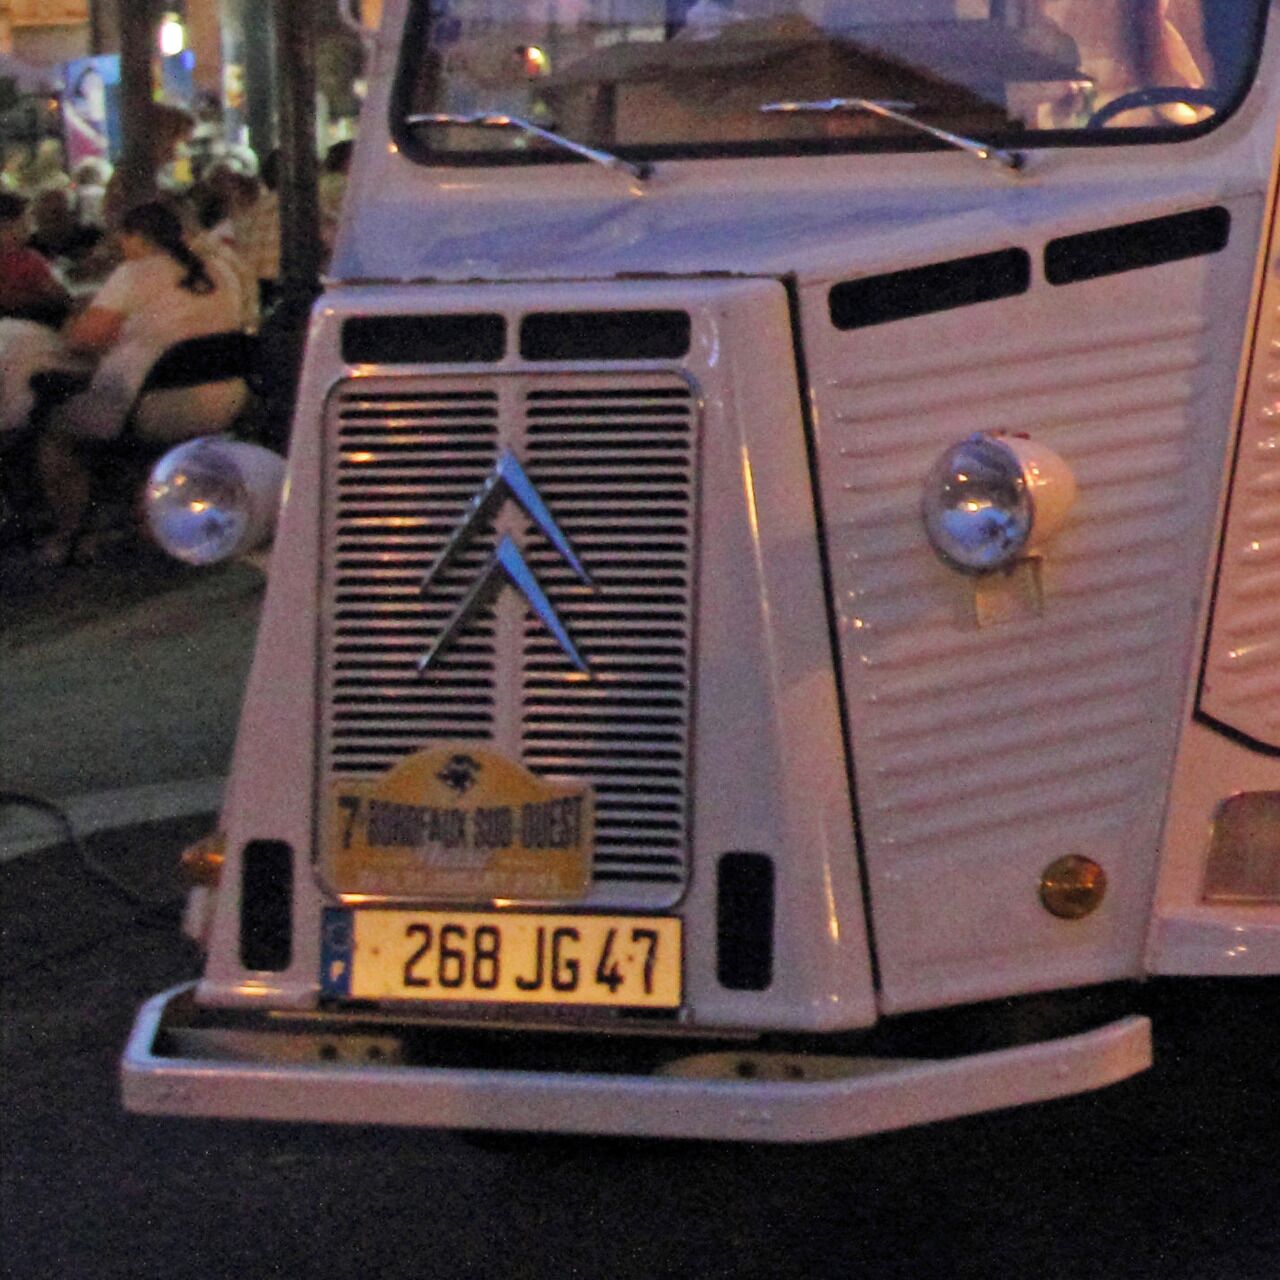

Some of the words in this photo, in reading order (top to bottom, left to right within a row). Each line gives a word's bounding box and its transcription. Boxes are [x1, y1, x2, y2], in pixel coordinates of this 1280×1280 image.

[403, 923, 500, 989] 268
[515, 926, 580, 991] JG
[596, 928, 658, 994] 47
